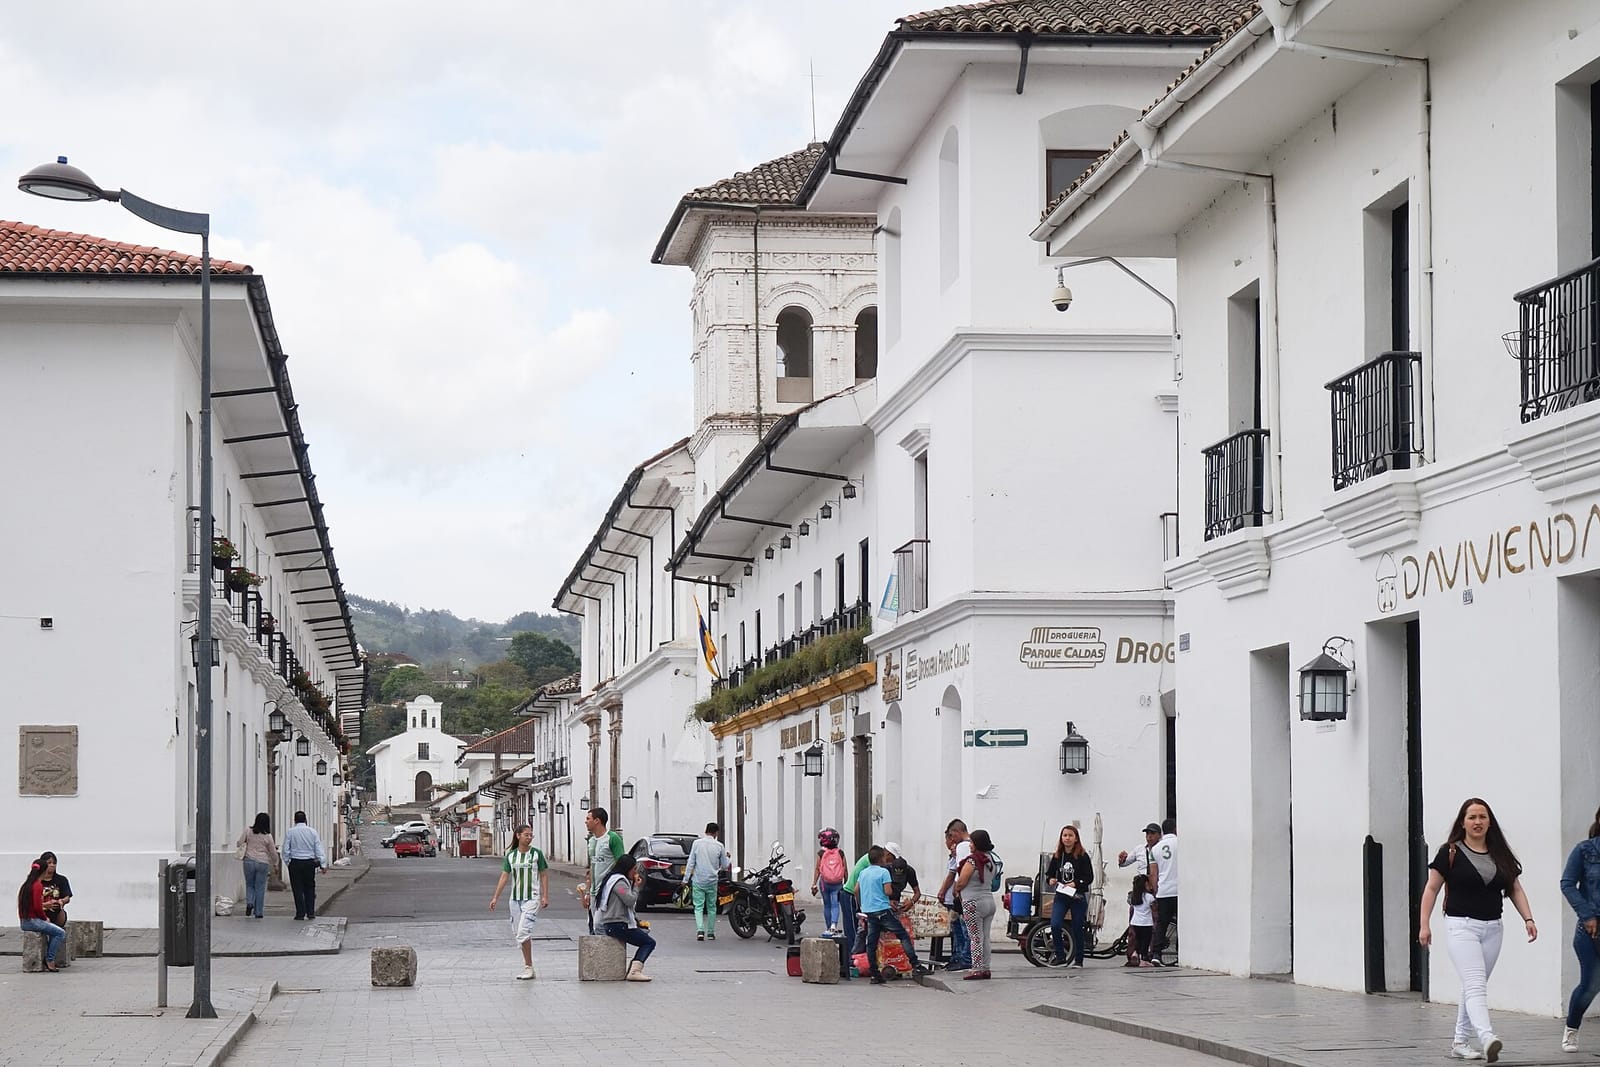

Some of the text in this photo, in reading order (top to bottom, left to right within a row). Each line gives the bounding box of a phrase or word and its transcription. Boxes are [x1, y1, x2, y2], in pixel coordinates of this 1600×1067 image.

[1401, 503, 1600, 599] DAVIVIENDA
[1050, 632, 1096, 640] DROGUERIA
[1022, 646, 1104, 658] PARQUE CALDAS
[1161, 845, 1172, 860] 3
